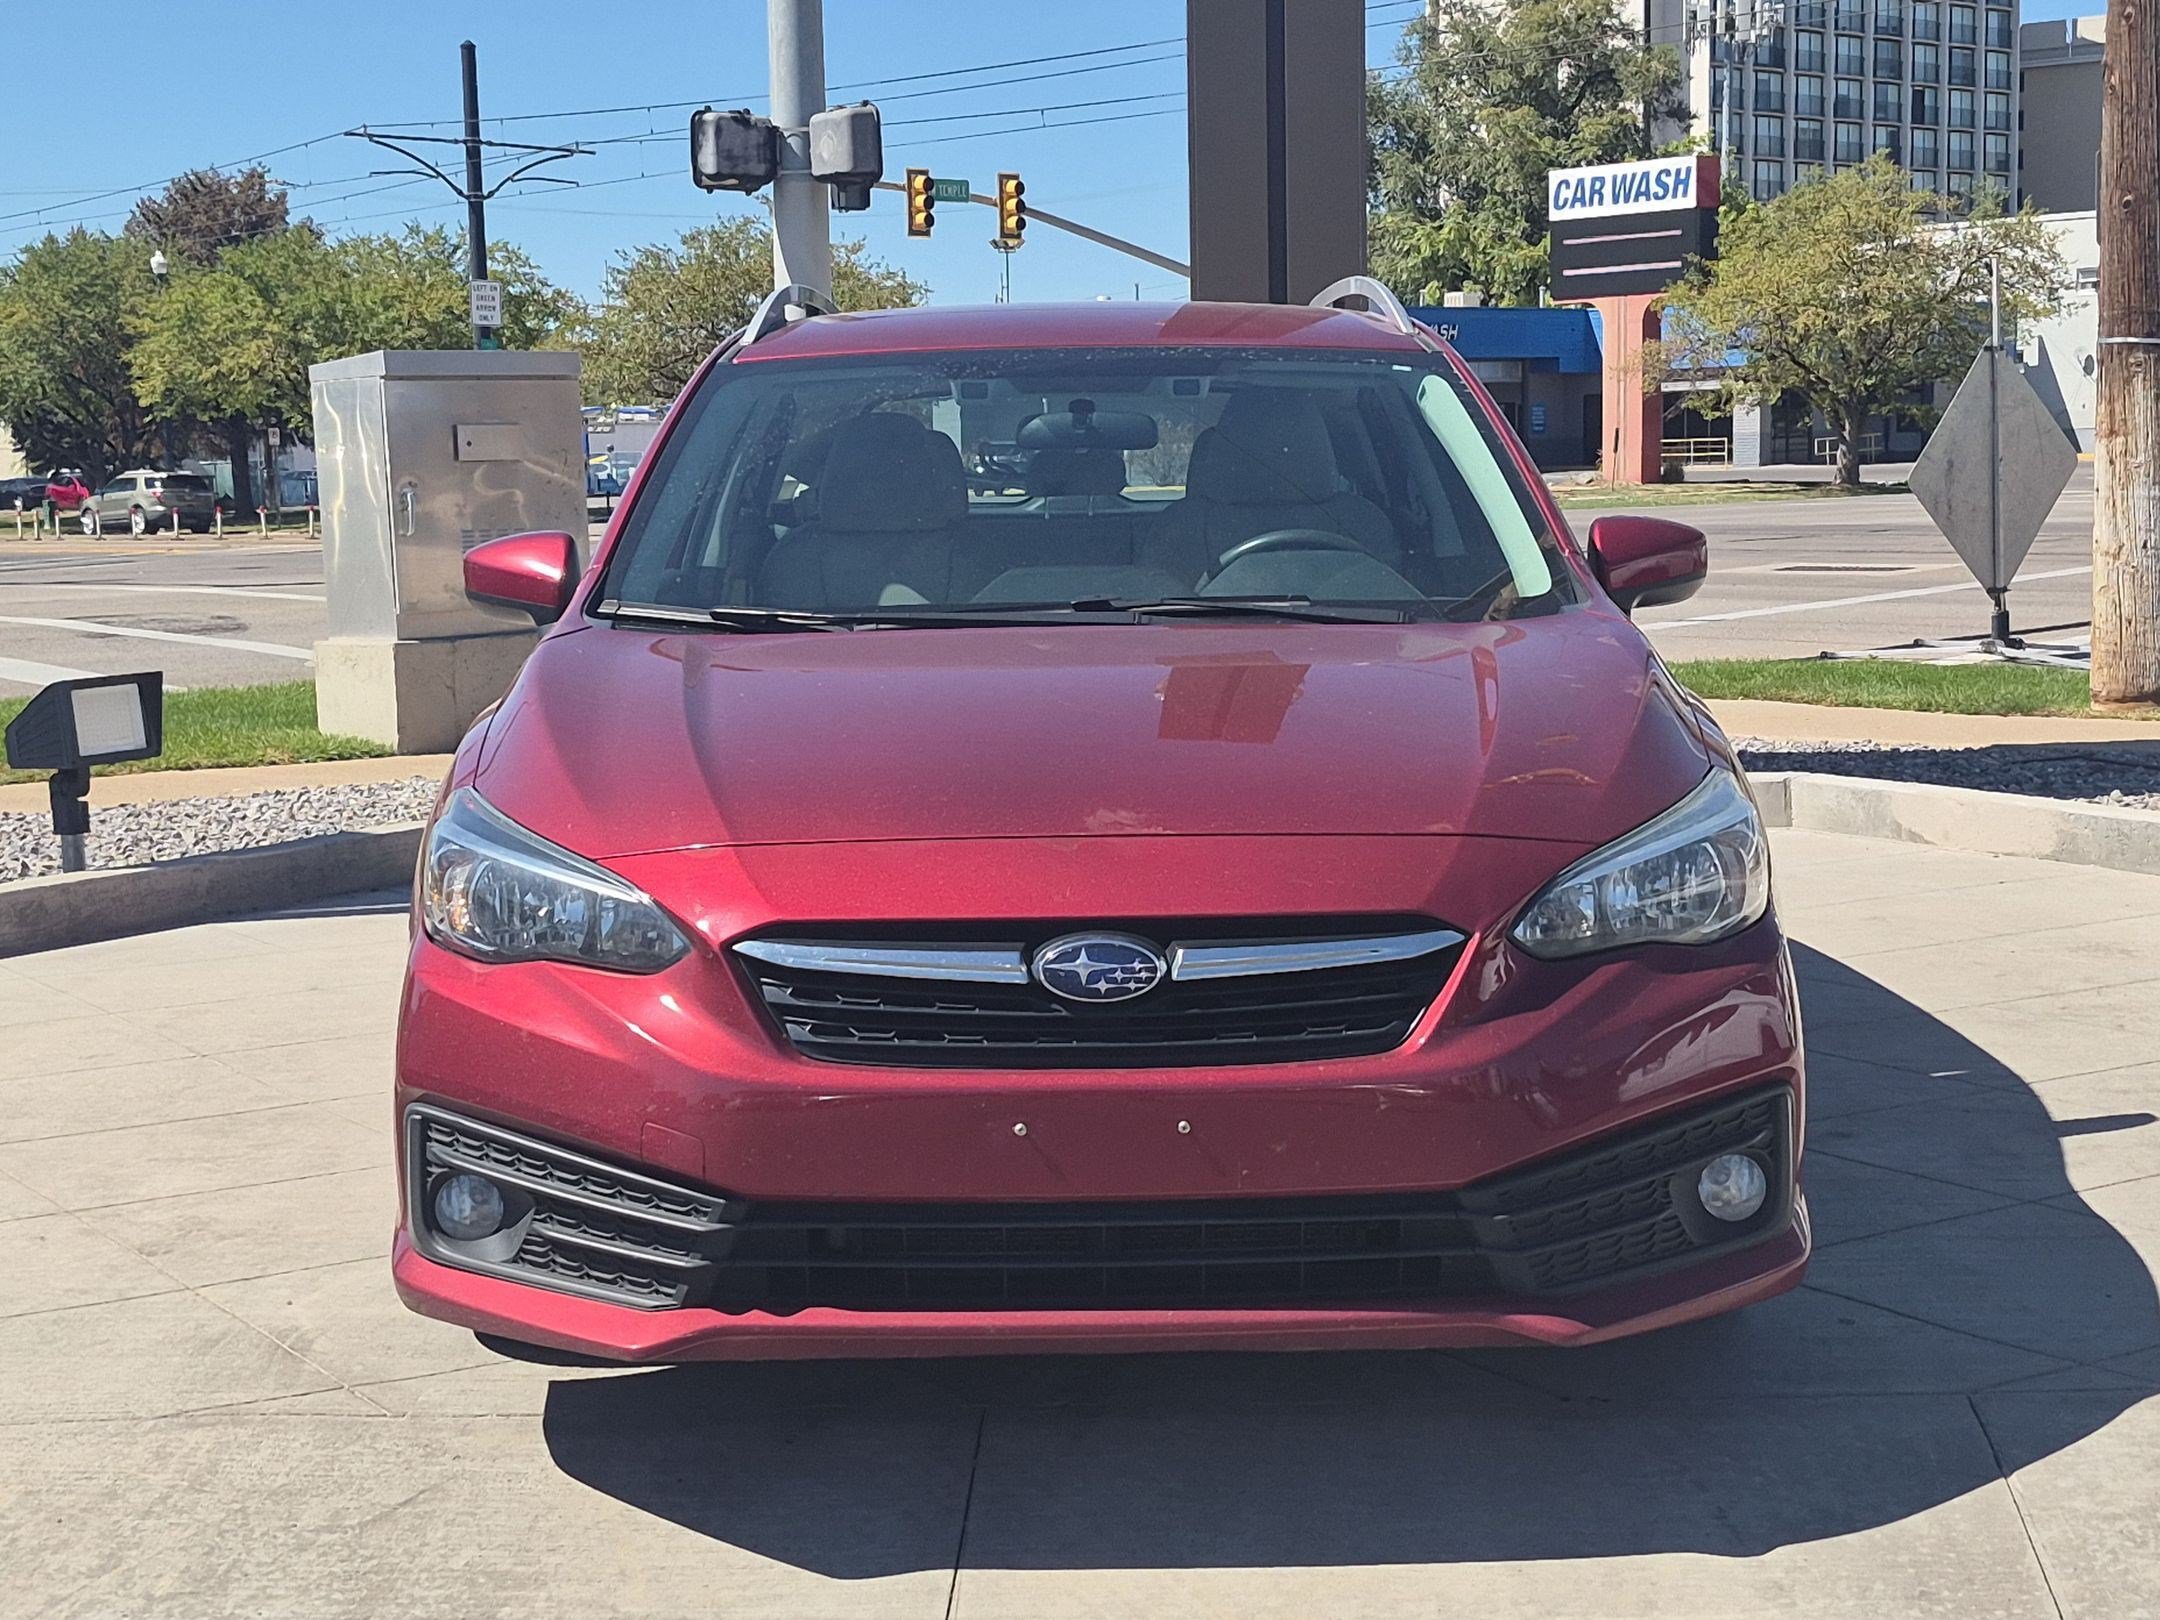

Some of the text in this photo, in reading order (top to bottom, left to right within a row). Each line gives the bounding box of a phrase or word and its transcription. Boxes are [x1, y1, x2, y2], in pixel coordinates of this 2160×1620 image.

[938, 184, 967, 198] TEMPLE
[1553, 166, 1692, 211] CAR WASH
[473, 284, 487, 292] LEFT
[476, 294, 496, 302] GREEN
[476, 304, 496, 312] ARROW
[1430, 324, 1459, 341] ASH
